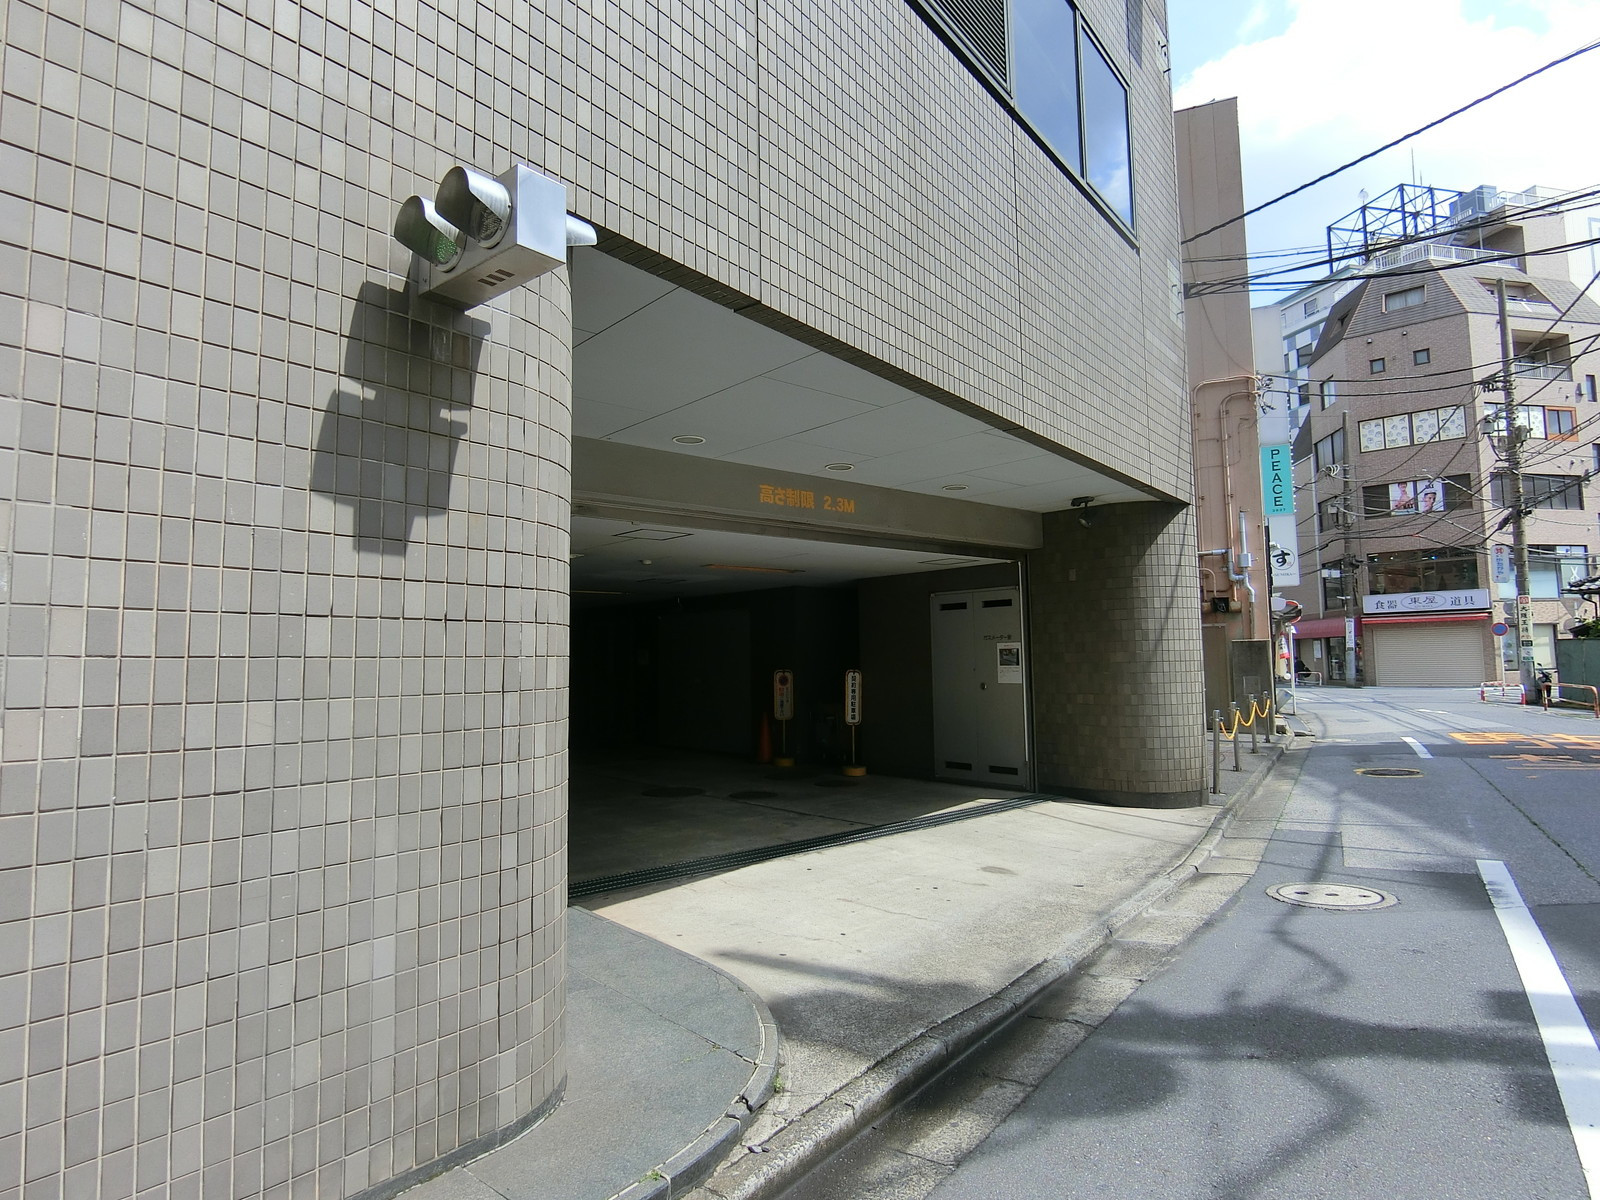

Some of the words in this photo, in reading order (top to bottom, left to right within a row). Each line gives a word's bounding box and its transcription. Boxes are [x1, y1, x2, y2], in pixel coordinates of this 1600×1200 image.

[1271, 449, 1283, 506] PEACE
[758, 484, 815, 509] 高さ制限
[823, 495, 855, 513] 2.3M
[1272, 550, 1291, 567] す
[1375, 600, 1397, 610] 食器
[1450, 595, 1475, 606] 道具
